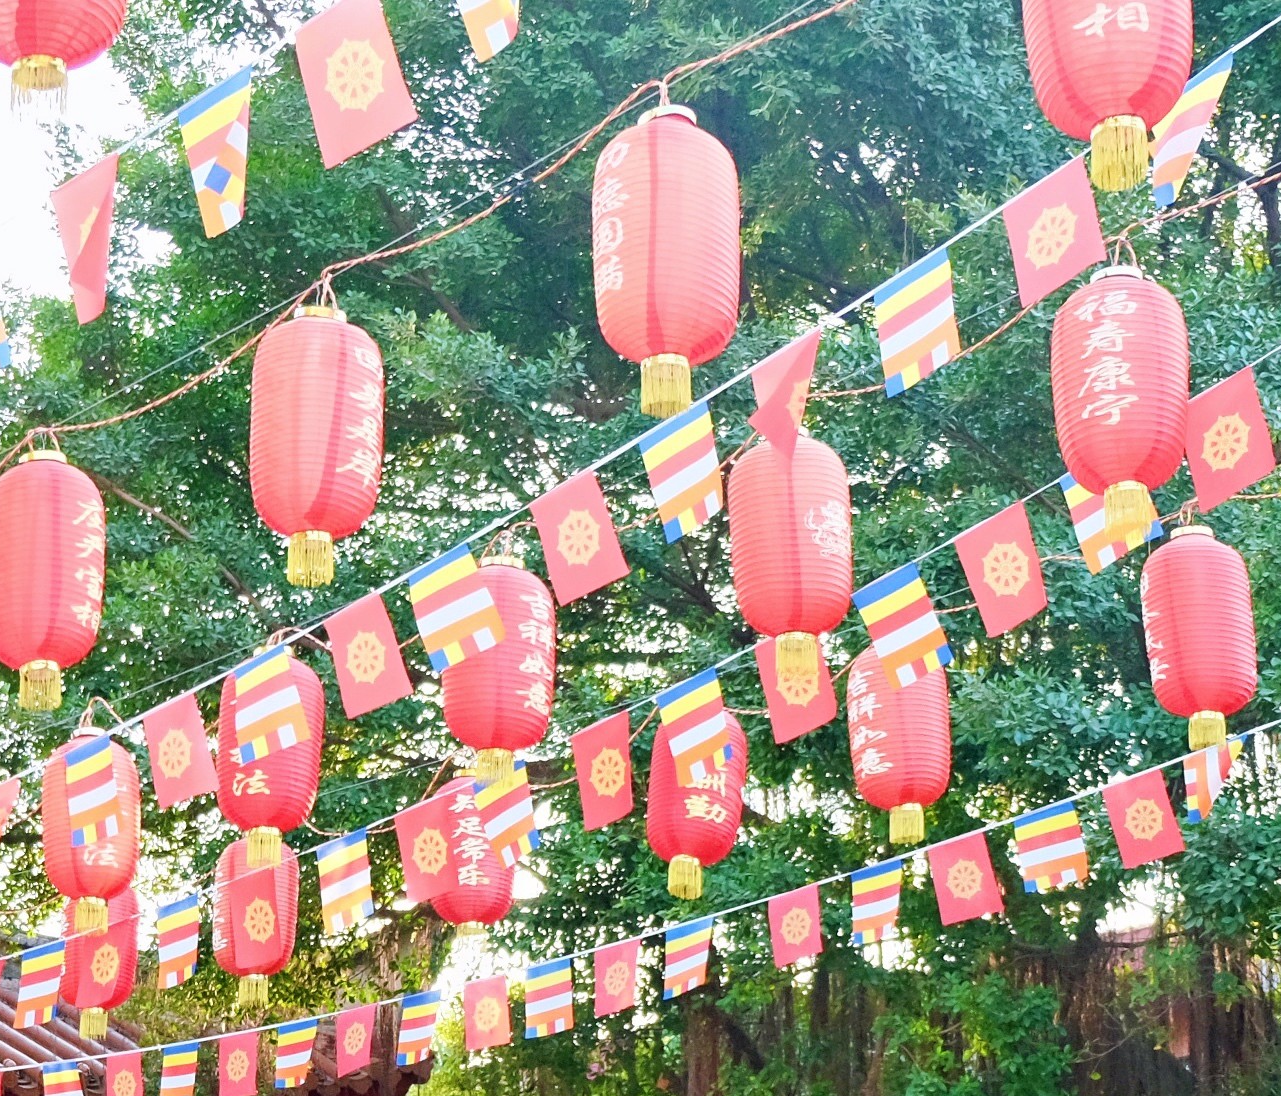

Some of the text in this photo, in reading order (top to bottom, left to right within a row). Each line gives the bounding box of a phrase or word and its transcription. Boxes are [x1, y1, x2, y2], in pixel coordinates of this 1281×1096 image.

[1073, 289, 1140, 426] 福寿康宁
[515, 590, 556, 716] 吉祥如意
[847, 669, 894, 779] 吉祥如意
